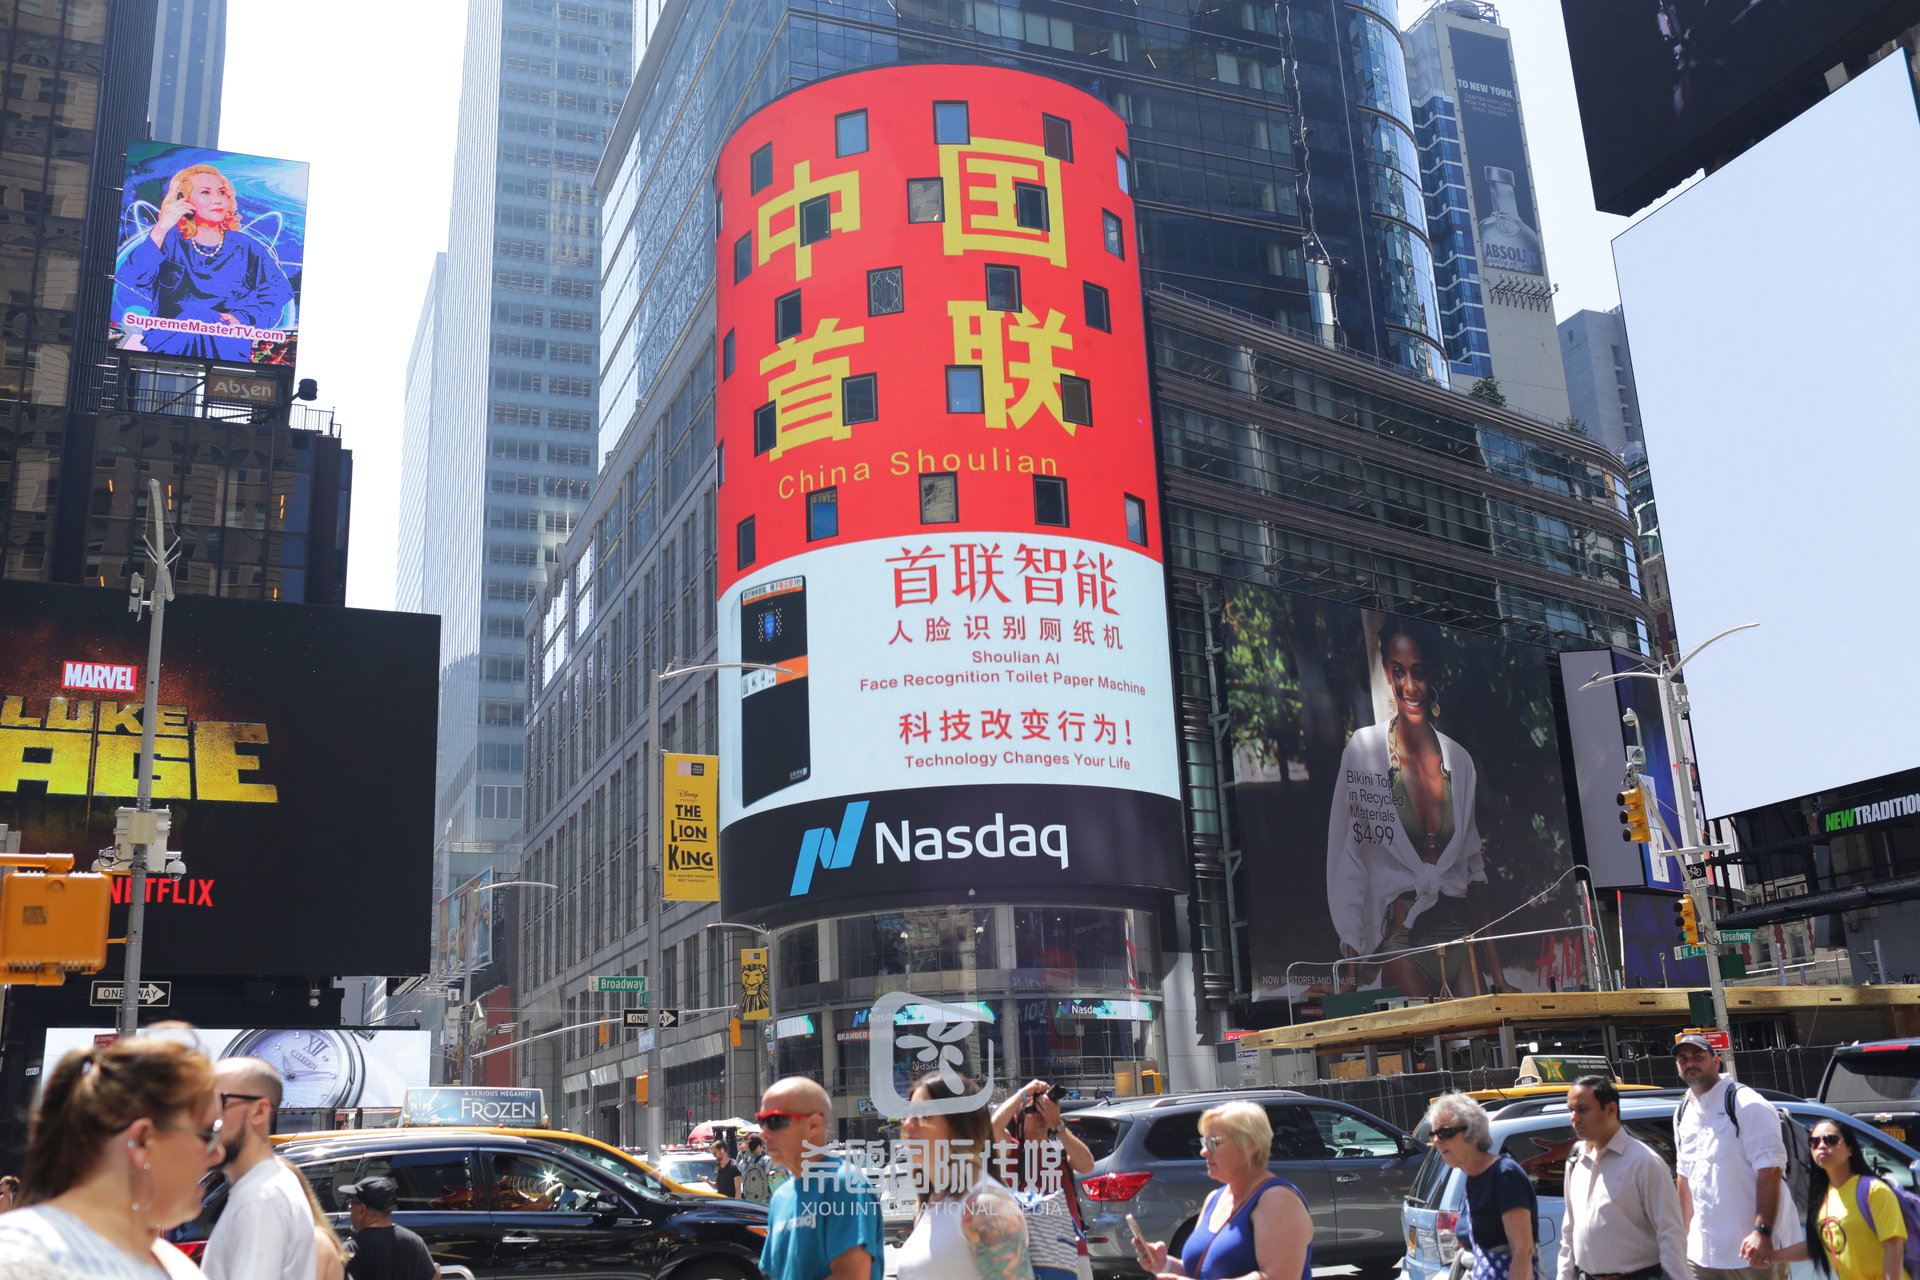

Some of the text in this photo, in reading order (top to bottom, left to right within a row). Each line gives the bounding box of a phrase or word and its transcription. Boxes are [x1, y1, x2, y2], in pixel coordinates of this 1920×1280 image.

[1457, 79, 1469, 89] TO
[1469, 82, 1489, 93] NEW
[757, 136, 1068, 282] 中国
[126, 314, 284, 341] SupremeMasterTV.com
[214, 379, 272, 399] Absen
[759, 300, 1078, 462] 首联
[778, 448, 1058, 499] China Shoulian
[885, 542, 1121, 616] 首联智能
[887, 615, 1124, 650] 人脸识别厕纸机
[972, 649, 1060, 665] Shoulian AI
[63, 663, 135, 691] MARVEL
[860, 669, 1146, 696] Face Recognition Toilet Paper Machine
[0, 694, 189, 736] LUKE
[905, 751, 1131, 771] Technology Changes Your Life
[1346, 770, 1394, 791] Bikini Top
[1348, 788, 1404, 807] in Recycled
[675, 804, 702, 818] THE
[1350, 805, 1395, 823] Materials
[671, 820, 707, 842] LION
[1353, 821, 1394, 845] $4.99
[875, 813, 1070, 870] Nasdaq
[668, 844, 714, 871] KING
[1721, 932, 1751, 943] Broadway
[1535, 933, 1581, 990] H&M
[1682, 947, 1688, 956] W
[601, 978, 644, 992] Broadway
[1262, 975, 1279, 985] NOW
[1289, 976, 1316, 985] STORES
[1317, 977, 1332, 985] AND
[1336, 977, 1357, 985] NLINE
[103, 988, 124, 999] ONE
[631, 1014, 647, 1023] ONE
[868, 1013, 894, 1023] Nasd
[1071, 1004, 1096, 1015] Nasda
[836, 1031, 867, 1041] BRANDED
[912, 1060, 939, 1070] Nasd
[461, 1098, 536, 1122] FROZEN
